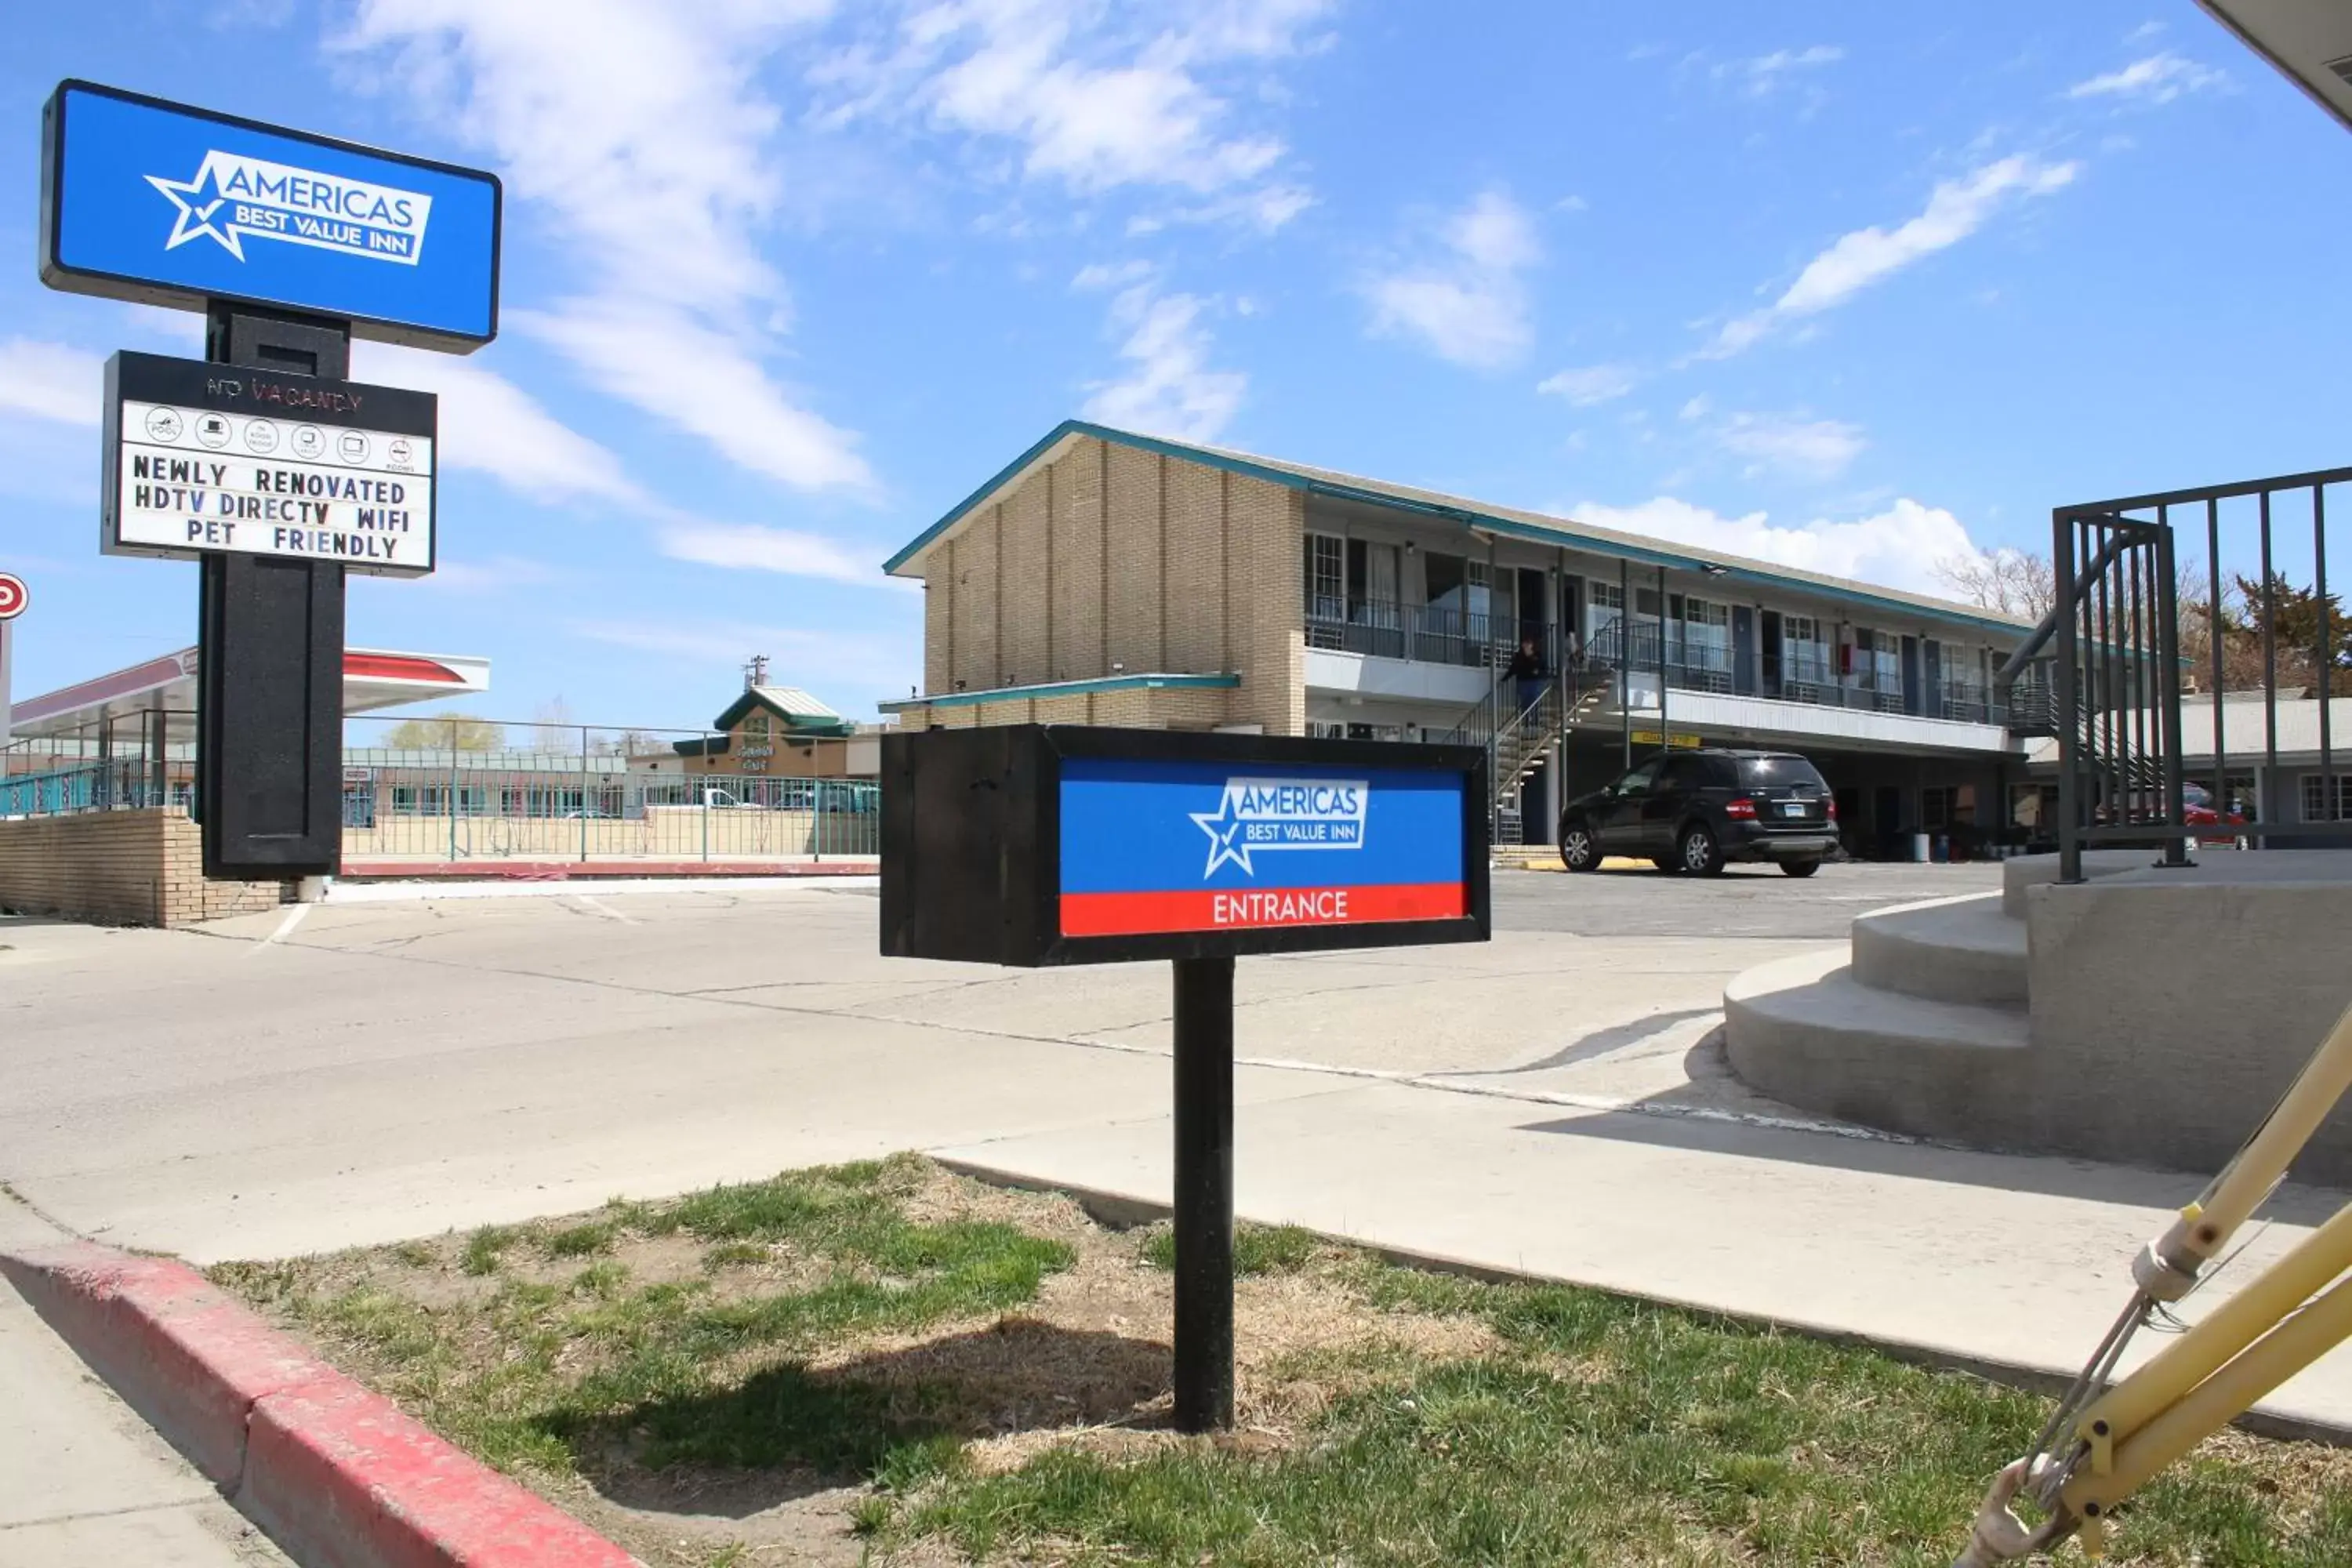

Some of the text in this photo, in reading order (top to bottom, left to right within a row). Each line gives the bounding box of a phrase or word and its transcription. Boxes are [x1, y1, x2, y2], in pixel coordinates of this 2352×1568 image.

[225, 165, 413, 228] AMERICAS
[235, 203, 408, 255] BEST VALUE INN
[206, 377, 362, 413] NO VACANCY
[133, 454, 405, 504] NEWLY RENOVATED
[135, 485, 408, 532] HDTV DIRECTV WIFI
[187, 519, 397, 559] PET FRIENDLY
[1240, 785, 1358, 815] AMERICAS
[1246, 824, 1356, 840] BEST VALUE INN
[1214, 891, 1348, 924] ENTRANCE
